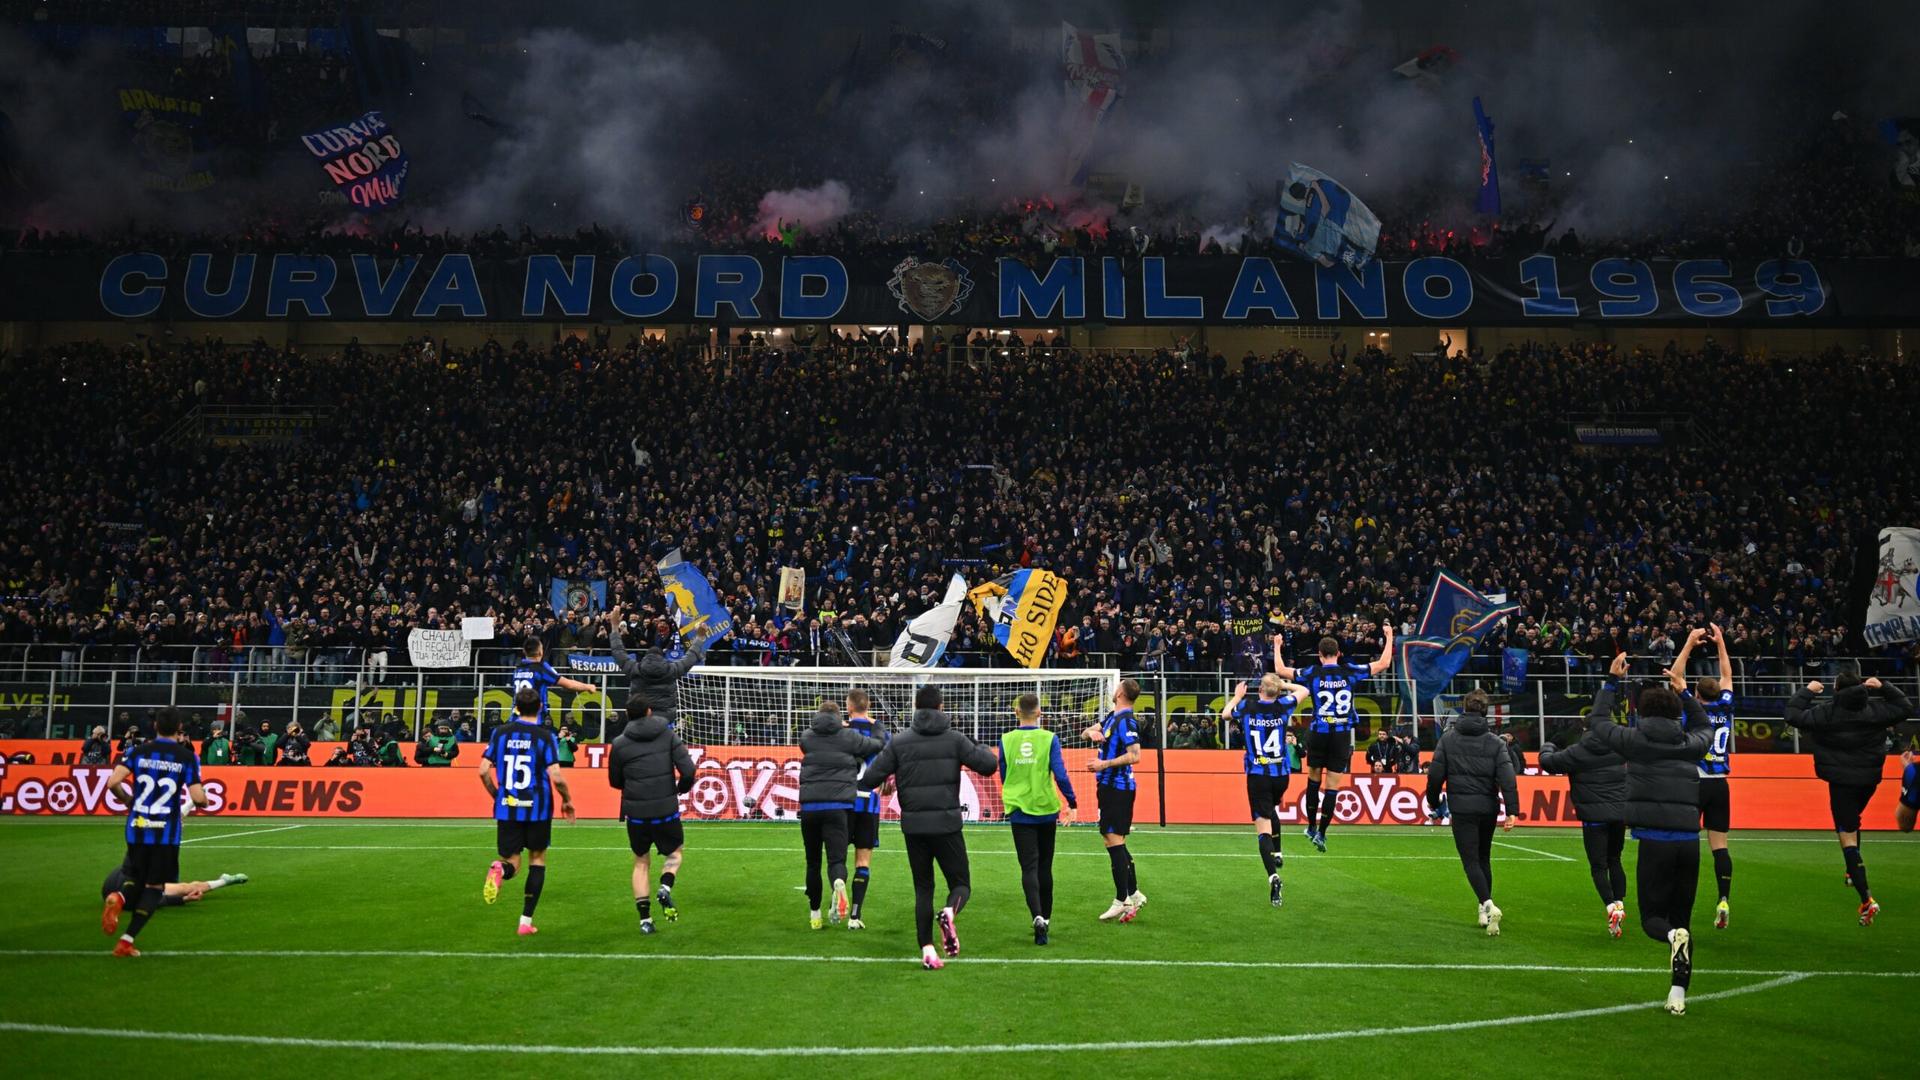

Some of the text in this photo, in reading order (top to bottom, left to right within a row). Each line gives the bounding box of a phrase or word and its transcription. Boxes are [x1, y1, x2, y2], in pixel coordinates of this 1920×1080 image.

[301, 114, 386, 157] CURVA
[323, 134, 401, 185] NORD
[100, 252, 488, 318] CURVA
[521, 254, 849, 319] NORD
[998, 256, 1474, 320] MILANO
[1519, 255, 1826, 318] 1969
[1026, 573, 1059, 627] SIDE
[1233, 618, 1263, 626] LAUTARO
[422, 630, 455, 641] CHALA
[1233, 625, 1246, 636] 10
[749, 639, 770, 648] AMO
[415, 651, 429, 660] TUA
[1319, 679, 1348, 688] PAVARD
[1316, 689, 1352, 715] 28
[1248, 717, 1284, 728] KLAASSEN
[506, 739, 532, 750] ACERBI
[1250, 728, 1282, 758] 14
[137, 757, 183, 773] MKHITARYAN
[503, 754, 532, 791] 15
[132, 773, 178, 815] 22
